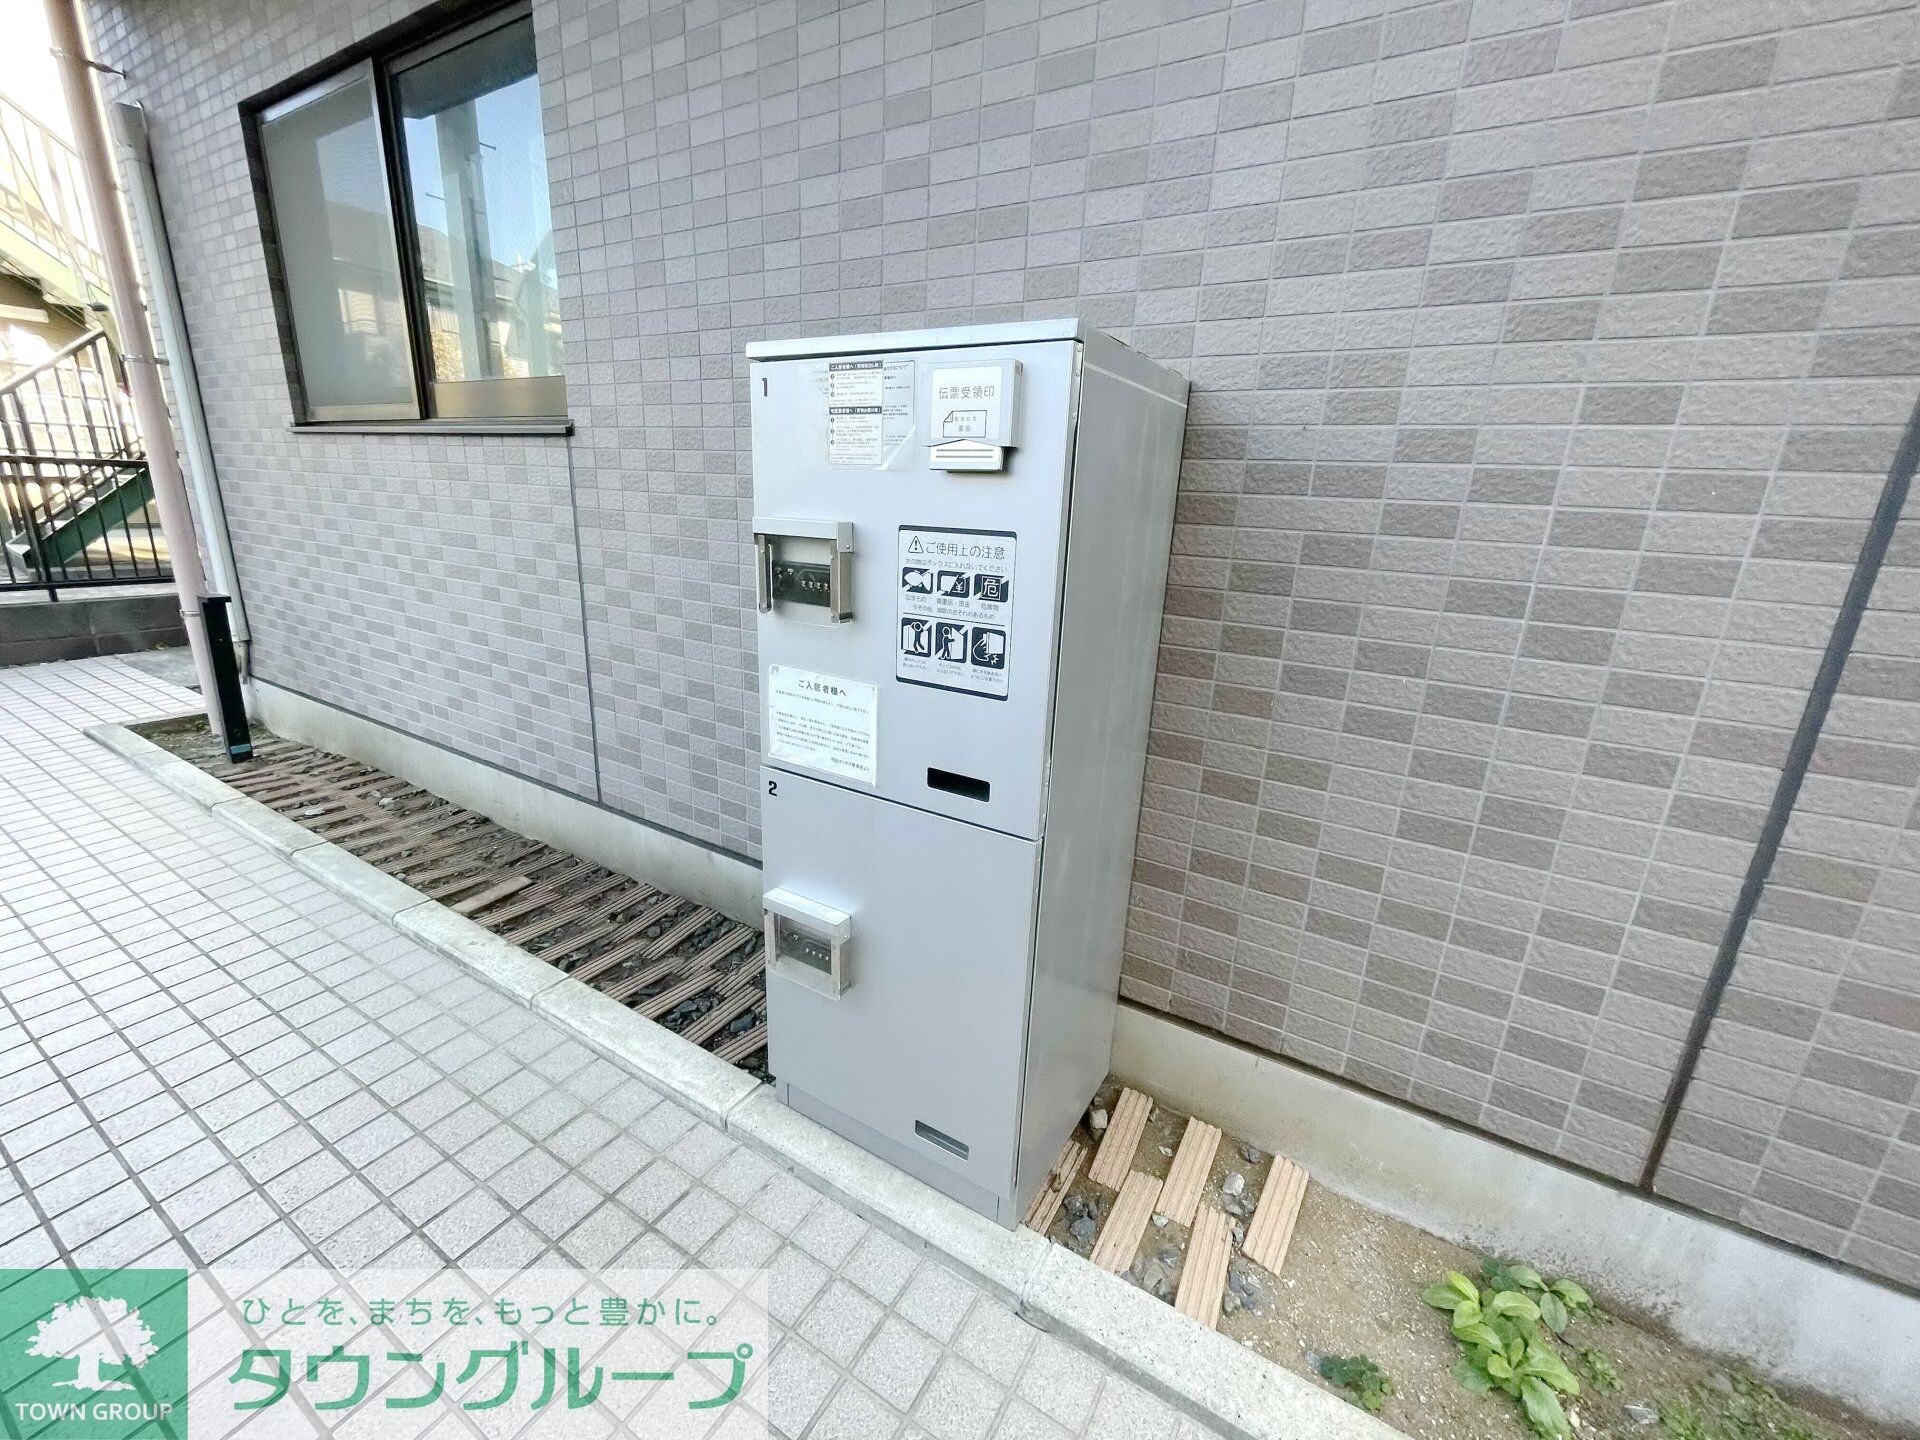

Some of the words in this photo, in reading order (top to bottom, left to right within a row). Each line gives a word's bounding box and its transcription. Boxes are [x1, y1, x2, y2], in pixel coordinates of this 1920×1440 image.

[762, 377, 768, 397] 1
[938, 385, 995, 400] 伝票受領印
[926, 541, 1005, 560] ご使用上の注意
[798, 679, 847, 697] ご入居者様へ
[768, 780, 778, 797] 2
